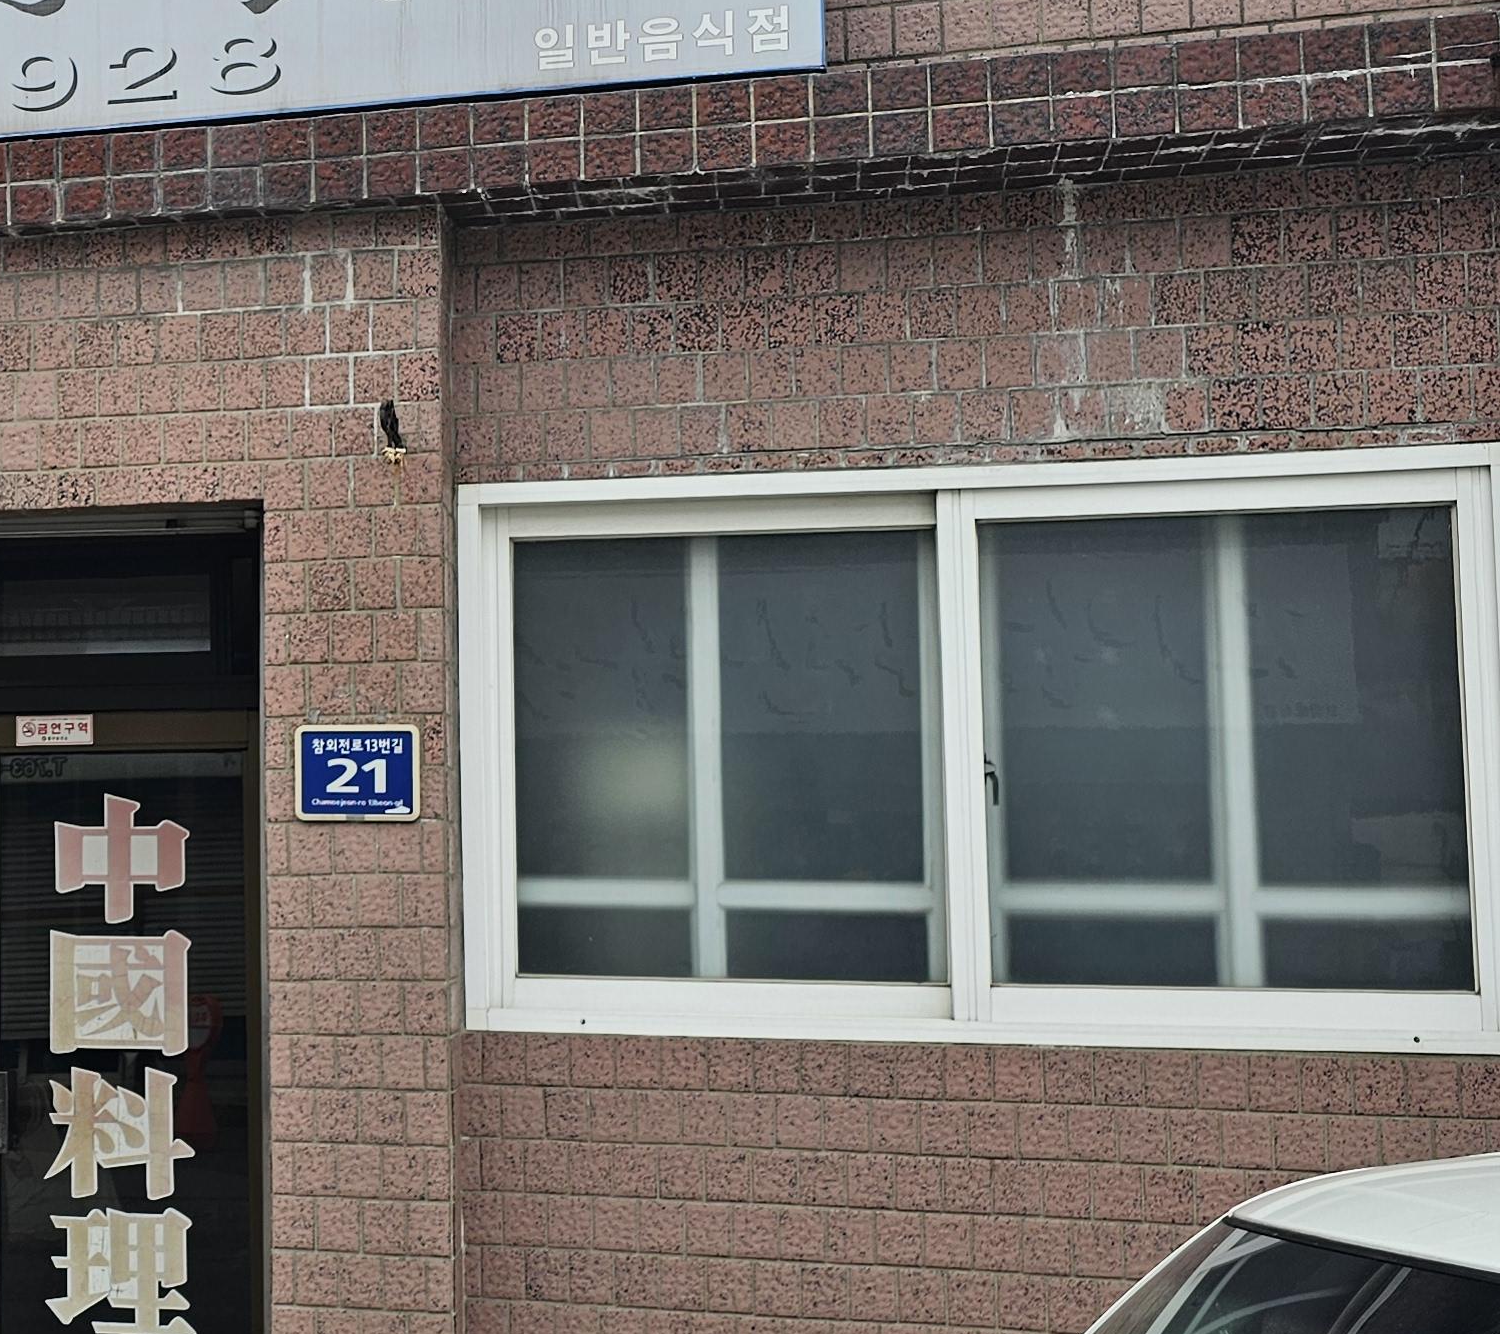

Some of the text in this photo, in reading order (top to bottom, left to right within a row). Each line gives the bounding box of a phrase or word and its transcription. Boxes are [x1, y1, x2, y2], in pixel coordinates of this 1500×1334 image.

[534, 4, 790, 71] 일반음식점
[37, 722, 88, 735] 금연구역
[311, 737, 403, 755] 참외전로13번길
[325, 757, 387, 794] 21
